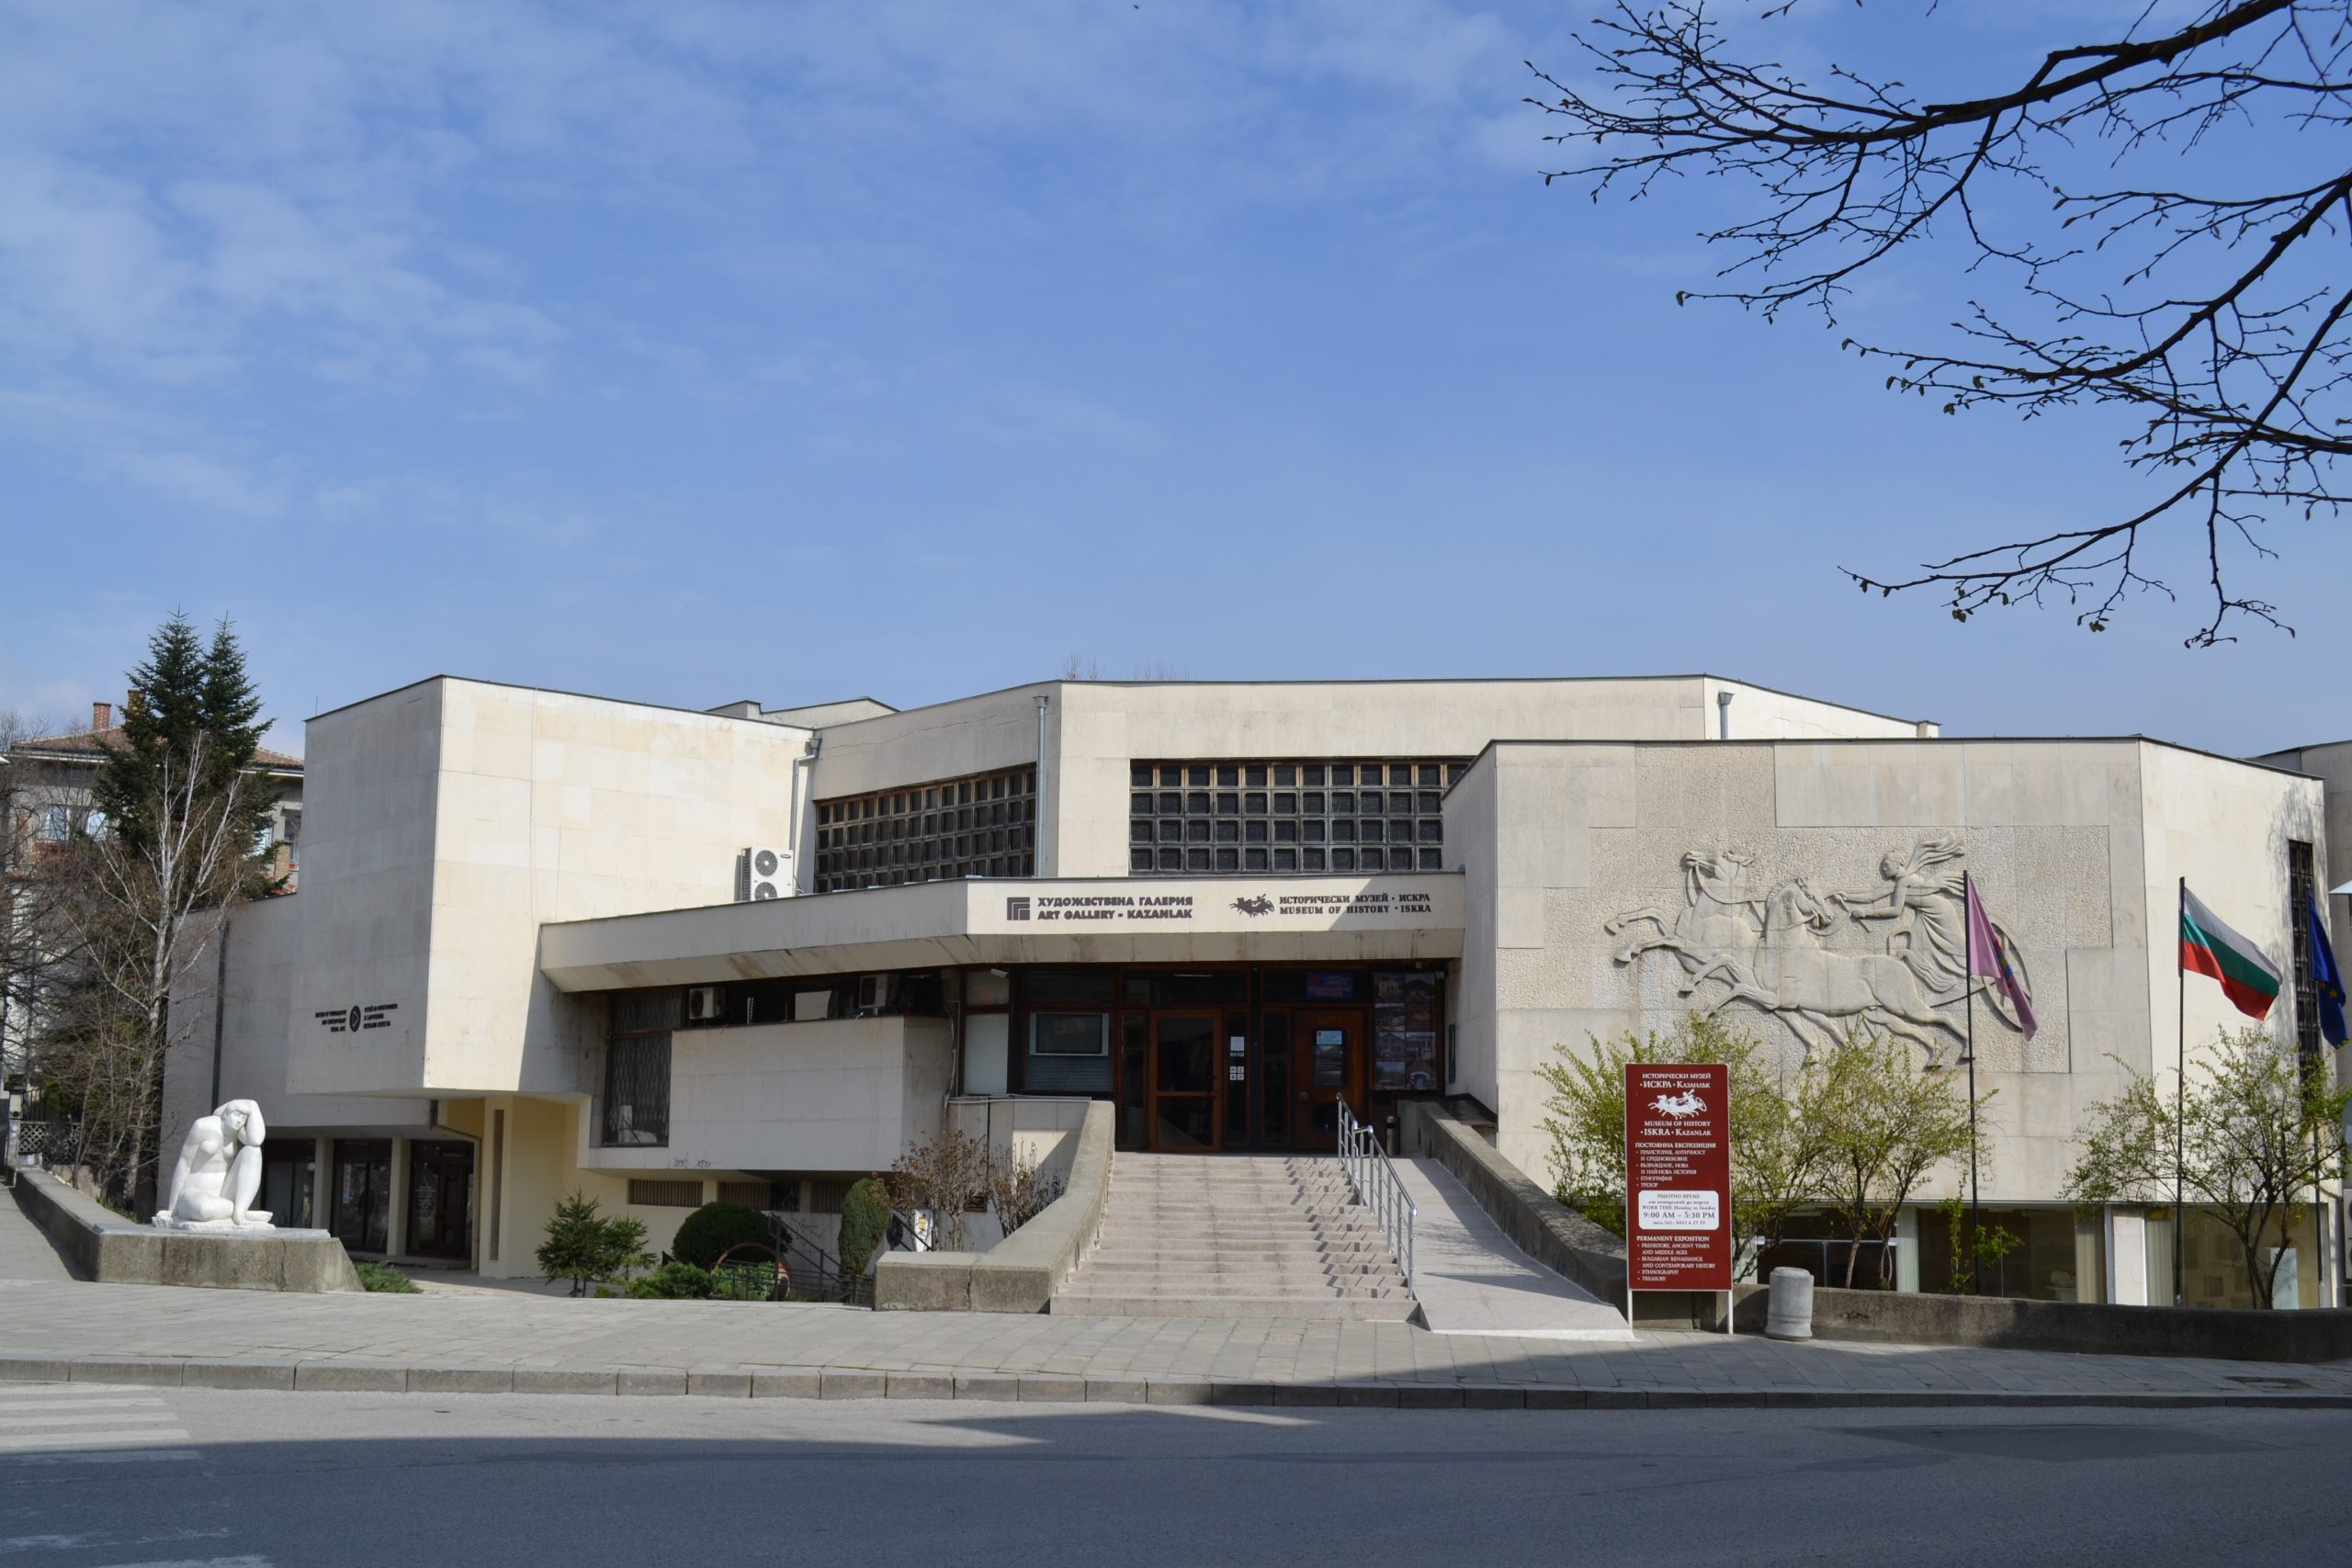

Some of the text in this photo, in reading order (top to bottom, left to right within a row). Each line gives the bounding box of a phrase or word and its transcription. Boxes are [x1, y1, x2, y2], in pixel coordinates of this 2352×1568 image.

[1038, 897, 1193, 907] ХУДОЖЕСТВЕНА ГАЛЕРИЯ
[1356, 893, 1388, 903] МУЗЕЙ
[1038, 911, 1060, 919] ART
[1064, 910, 1115, 919] GALLERY
[1127, 910, 1192, 918] KAZANLAK
[1280, 906, 1323, 914] MUSEUM
